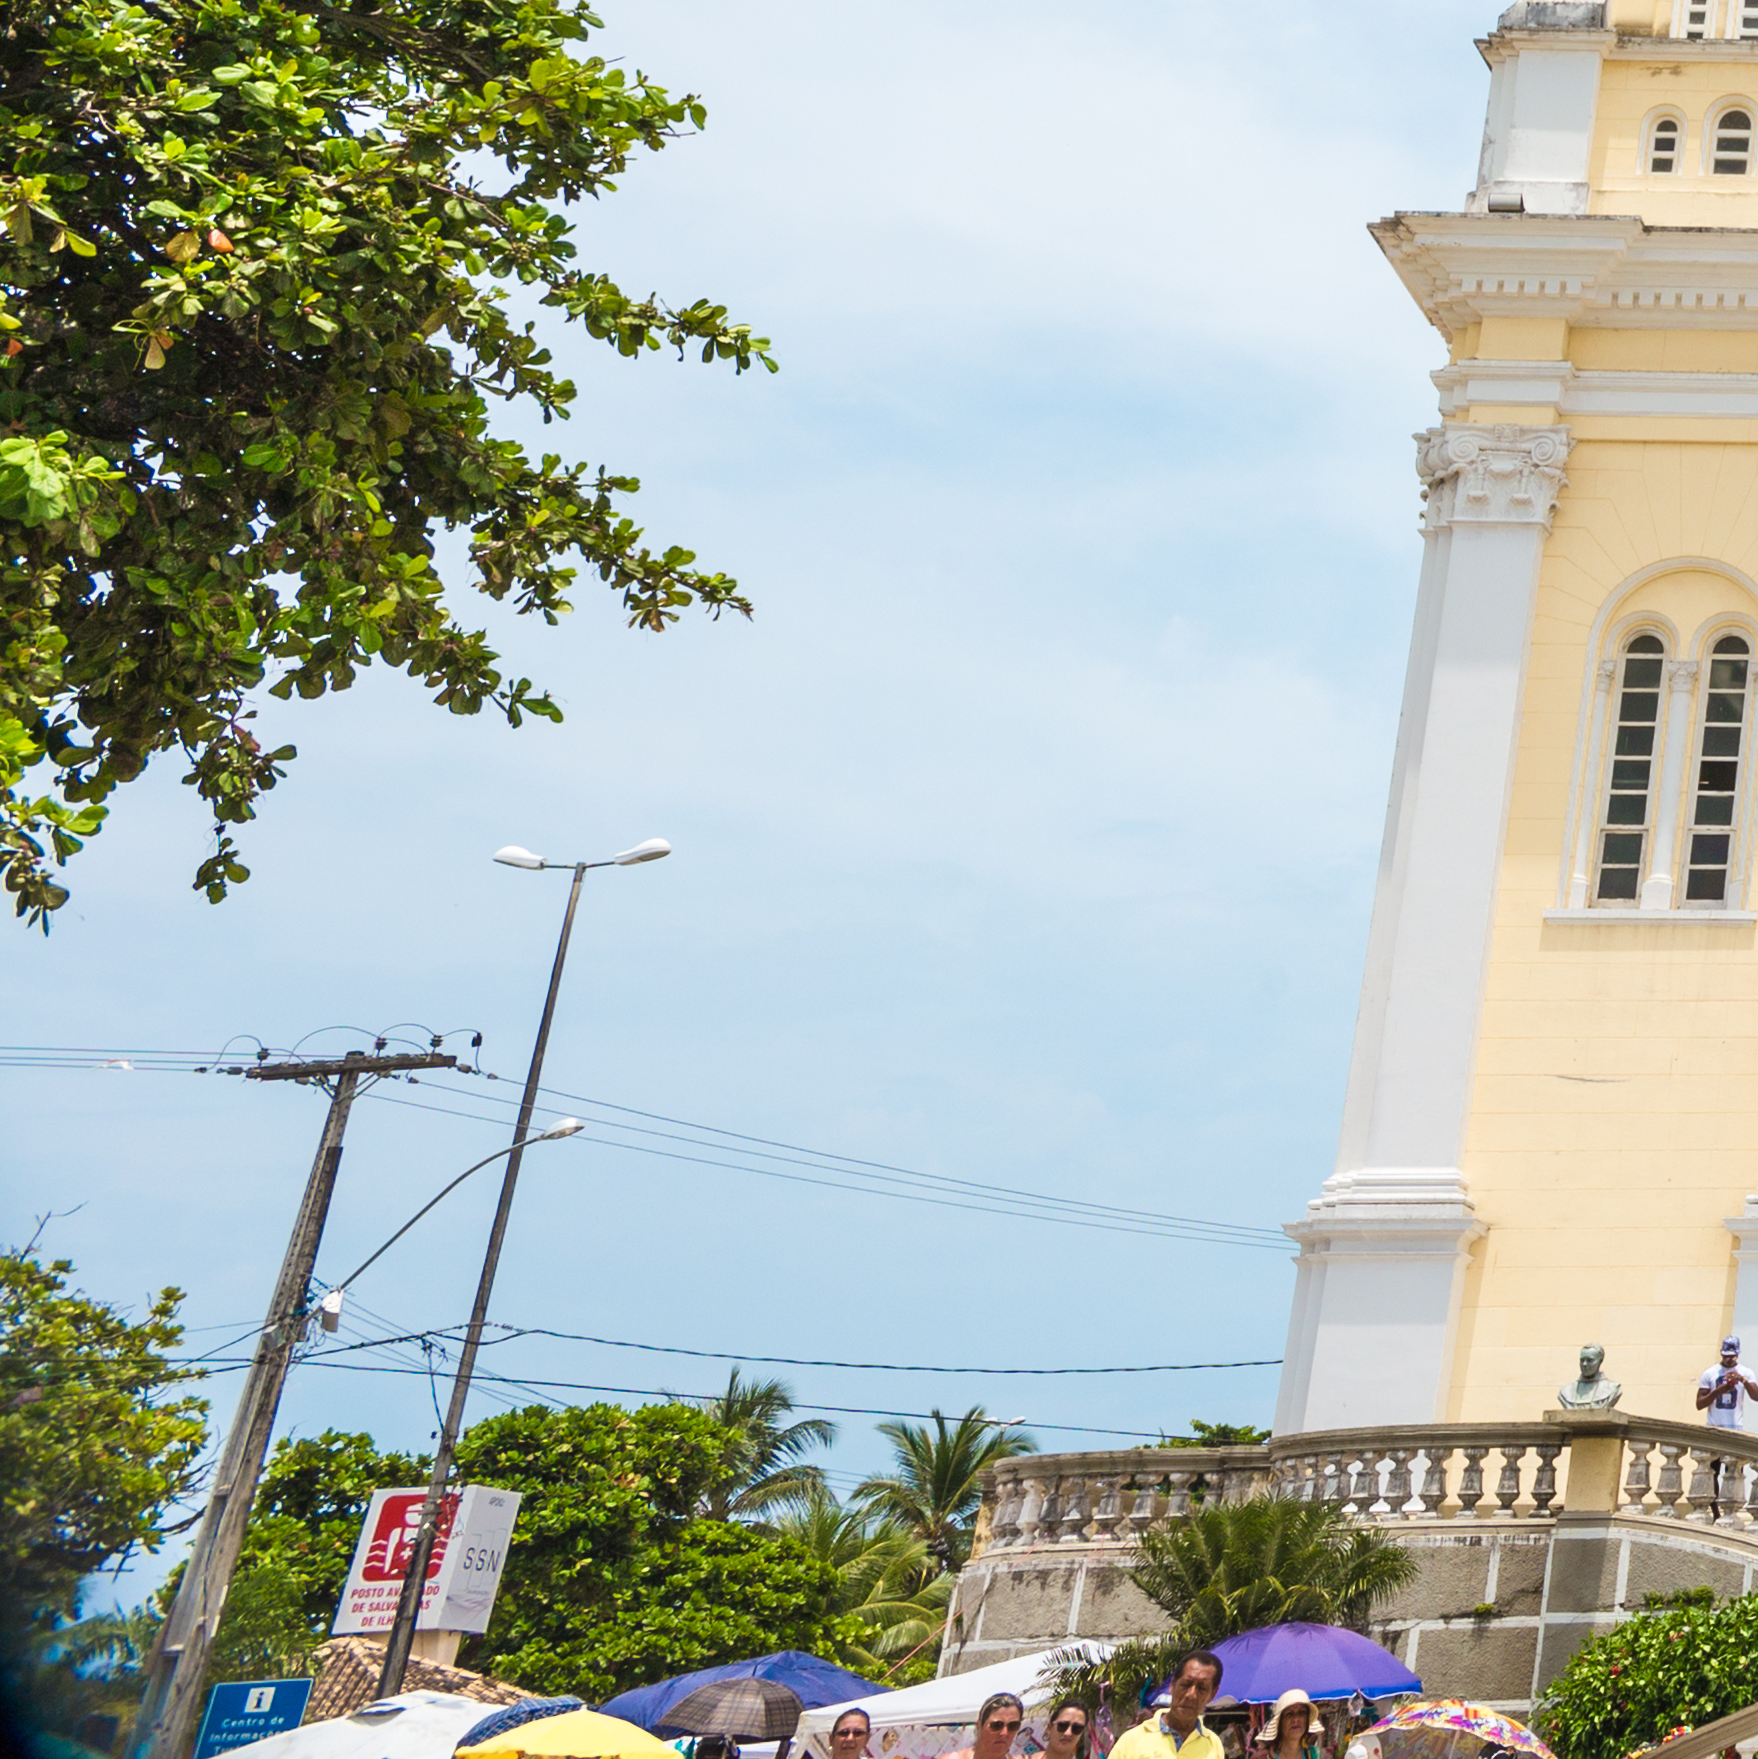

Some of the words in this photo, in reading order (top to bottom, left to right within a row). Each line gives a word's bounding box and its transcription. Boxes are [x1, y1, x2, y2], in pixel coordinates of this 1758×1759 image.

[463, 1547, 501, 1573] SSN
[351, 1587, 384, 1599] POSTO
[352, 1602, 365, 1613] DE
[361, 1616, 374, 1627] DE
[222, 1718, 265, 1728] Centro
[270, 1716, 285, 1725] de
